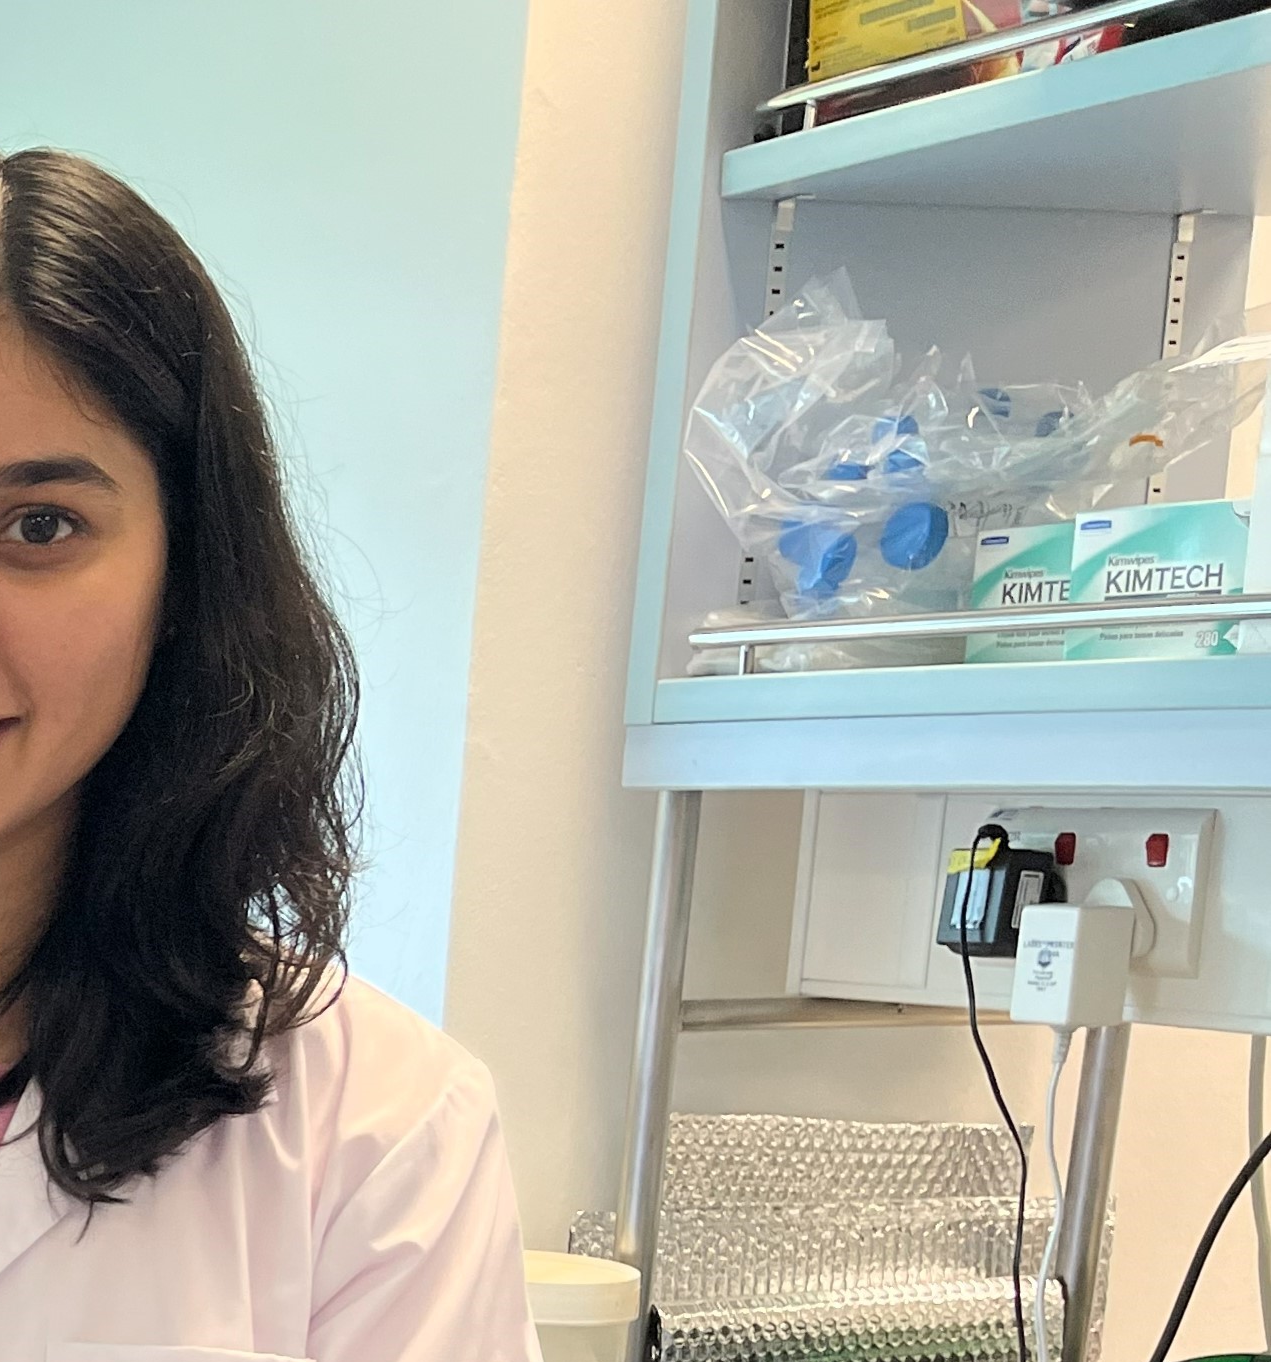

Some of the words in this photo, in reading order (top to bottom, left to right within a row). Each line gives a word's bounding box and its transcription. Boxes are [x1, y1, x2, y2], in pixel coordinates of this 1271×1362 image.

[1108, 556, 1155, 567] Kimwipes
[1105, 563, 1224, 594] KIMTECH
[1002, 579, 1071, 605] KIMTE
[1195, 631, 1219, 648] 280
